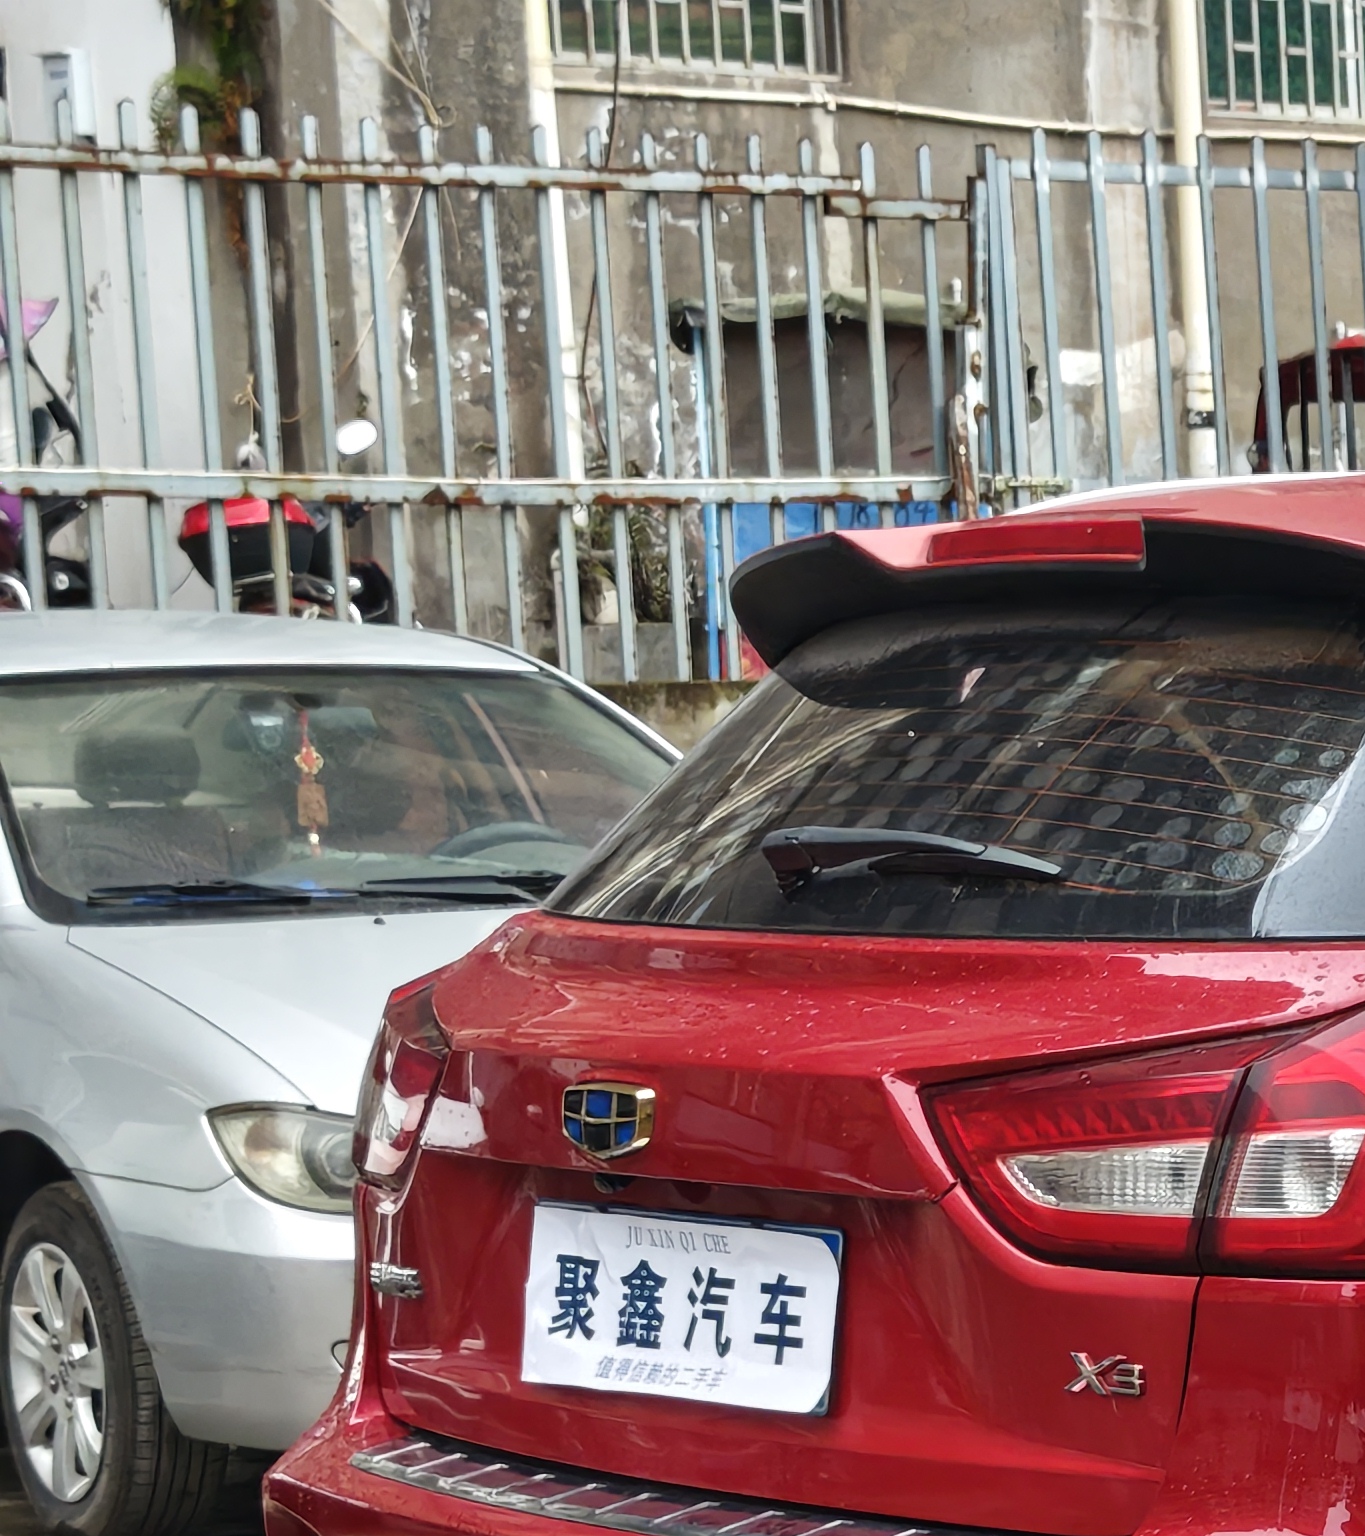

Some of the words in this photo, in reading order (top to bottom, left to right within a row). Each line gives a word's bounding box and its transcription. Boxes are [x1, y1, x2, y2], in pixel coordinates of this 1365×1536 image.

[625, 1225, 644, 1250] JU
[647, 1229, 675, 1251] XIN
[703, 1231, 732, 1255] CHE
[547, 1253, 809, 1366] 聚鑫汽车
[1063, 1351, 1145, 1397] X3
